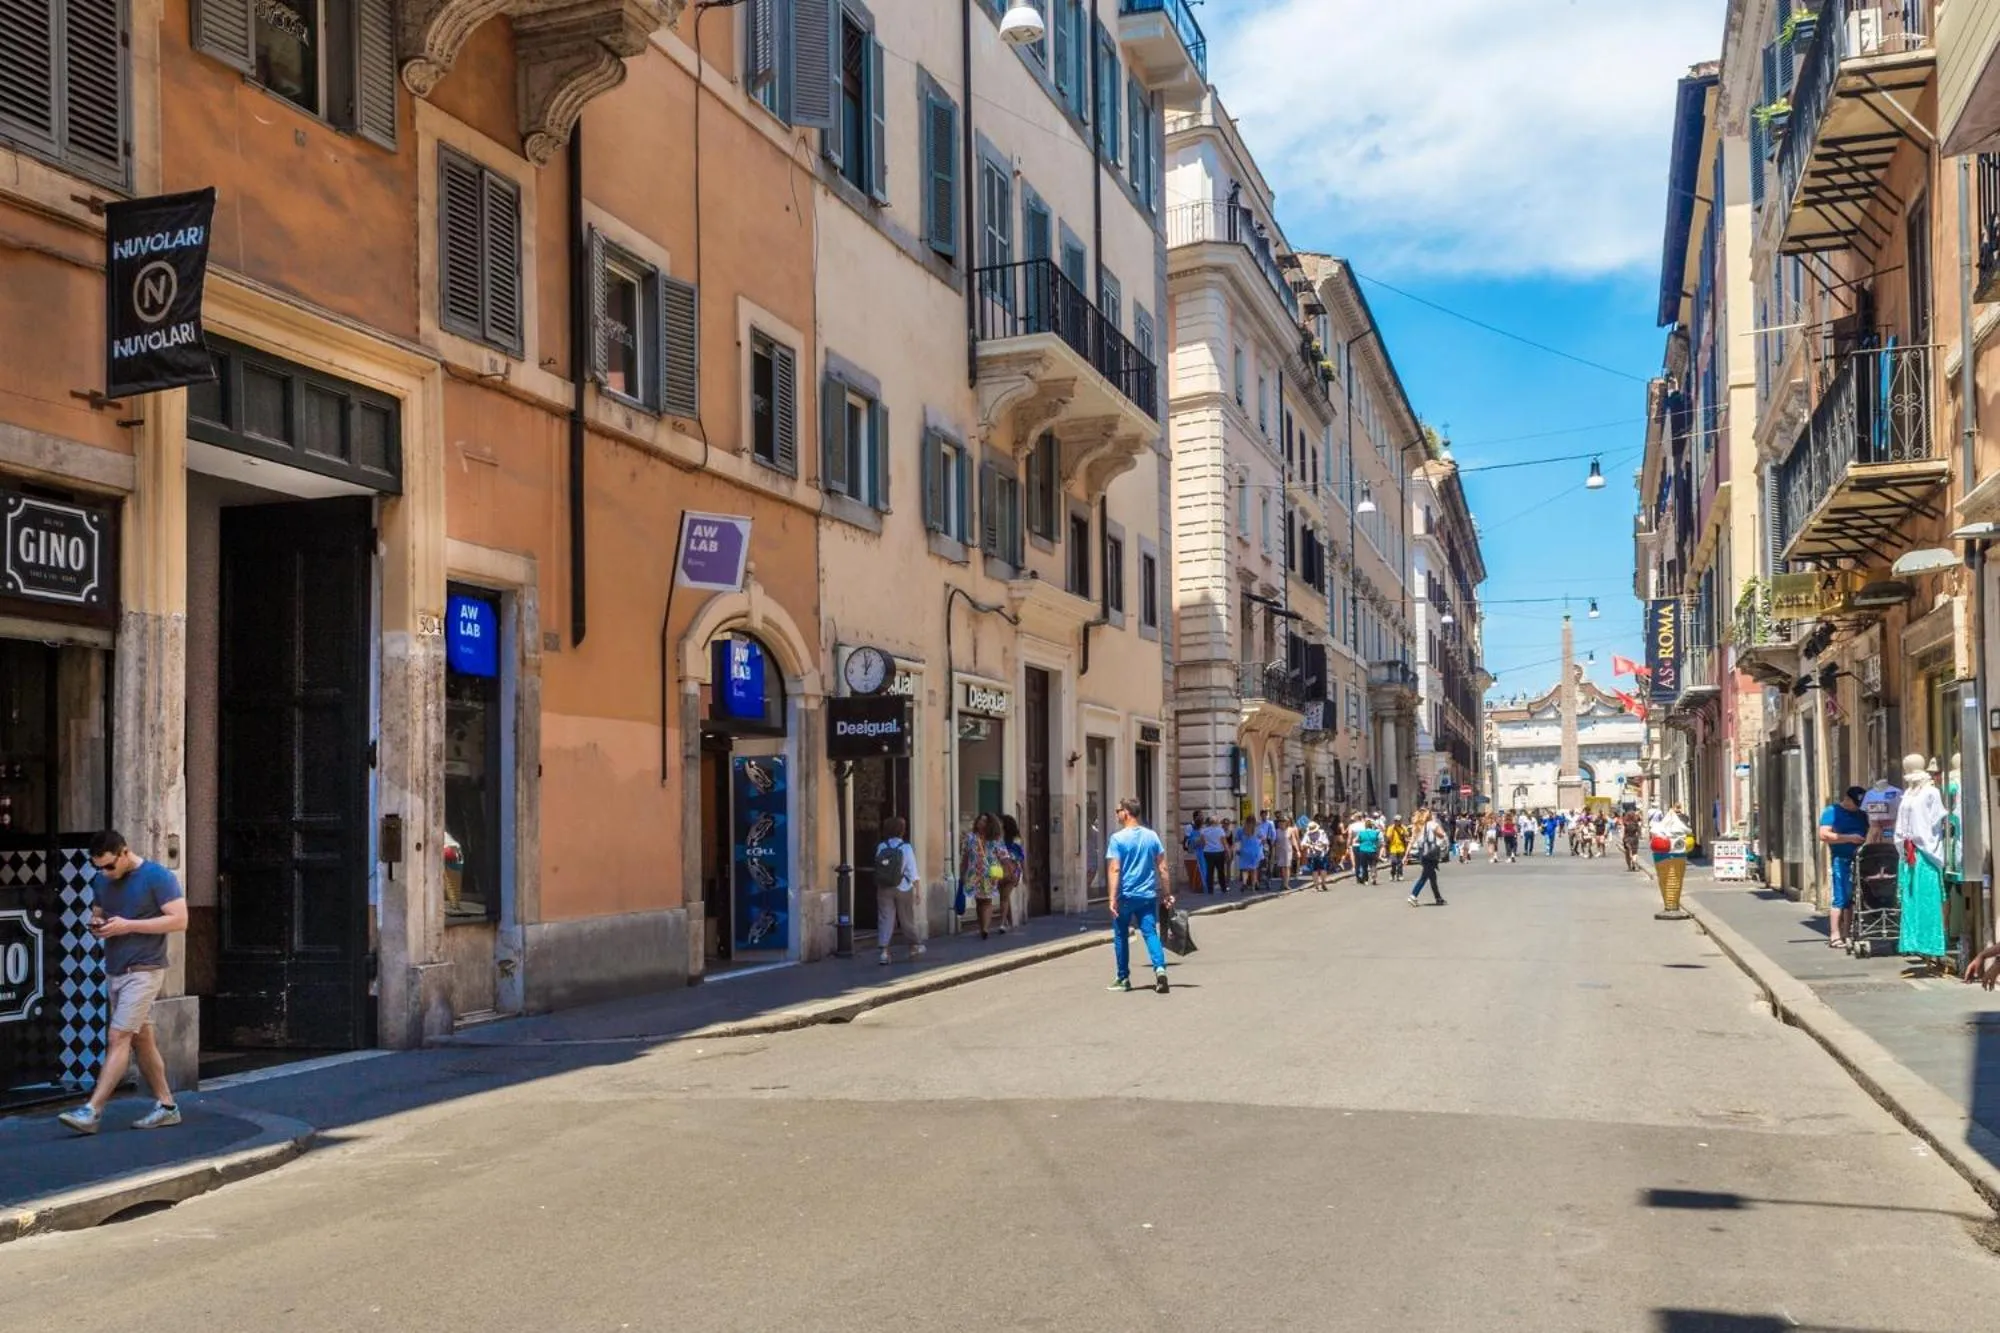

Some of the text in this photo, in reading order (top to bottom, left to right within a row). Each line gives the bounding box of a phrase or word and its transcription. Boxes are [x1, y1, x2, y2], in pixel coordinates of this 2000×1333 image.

[113, 225, 205, 261] NUVOLARI
[113, 321, 196, 359] NUVOLARI
[692, 524, 719, 538] AW
[18, 526, 86, 572] GINO
[689, 538, 719, 553] LAB
[460, 604, 479, 620] AW
[460, 620, 481, 638] LAB
[1657, 602, 1675, 660] ROMA
